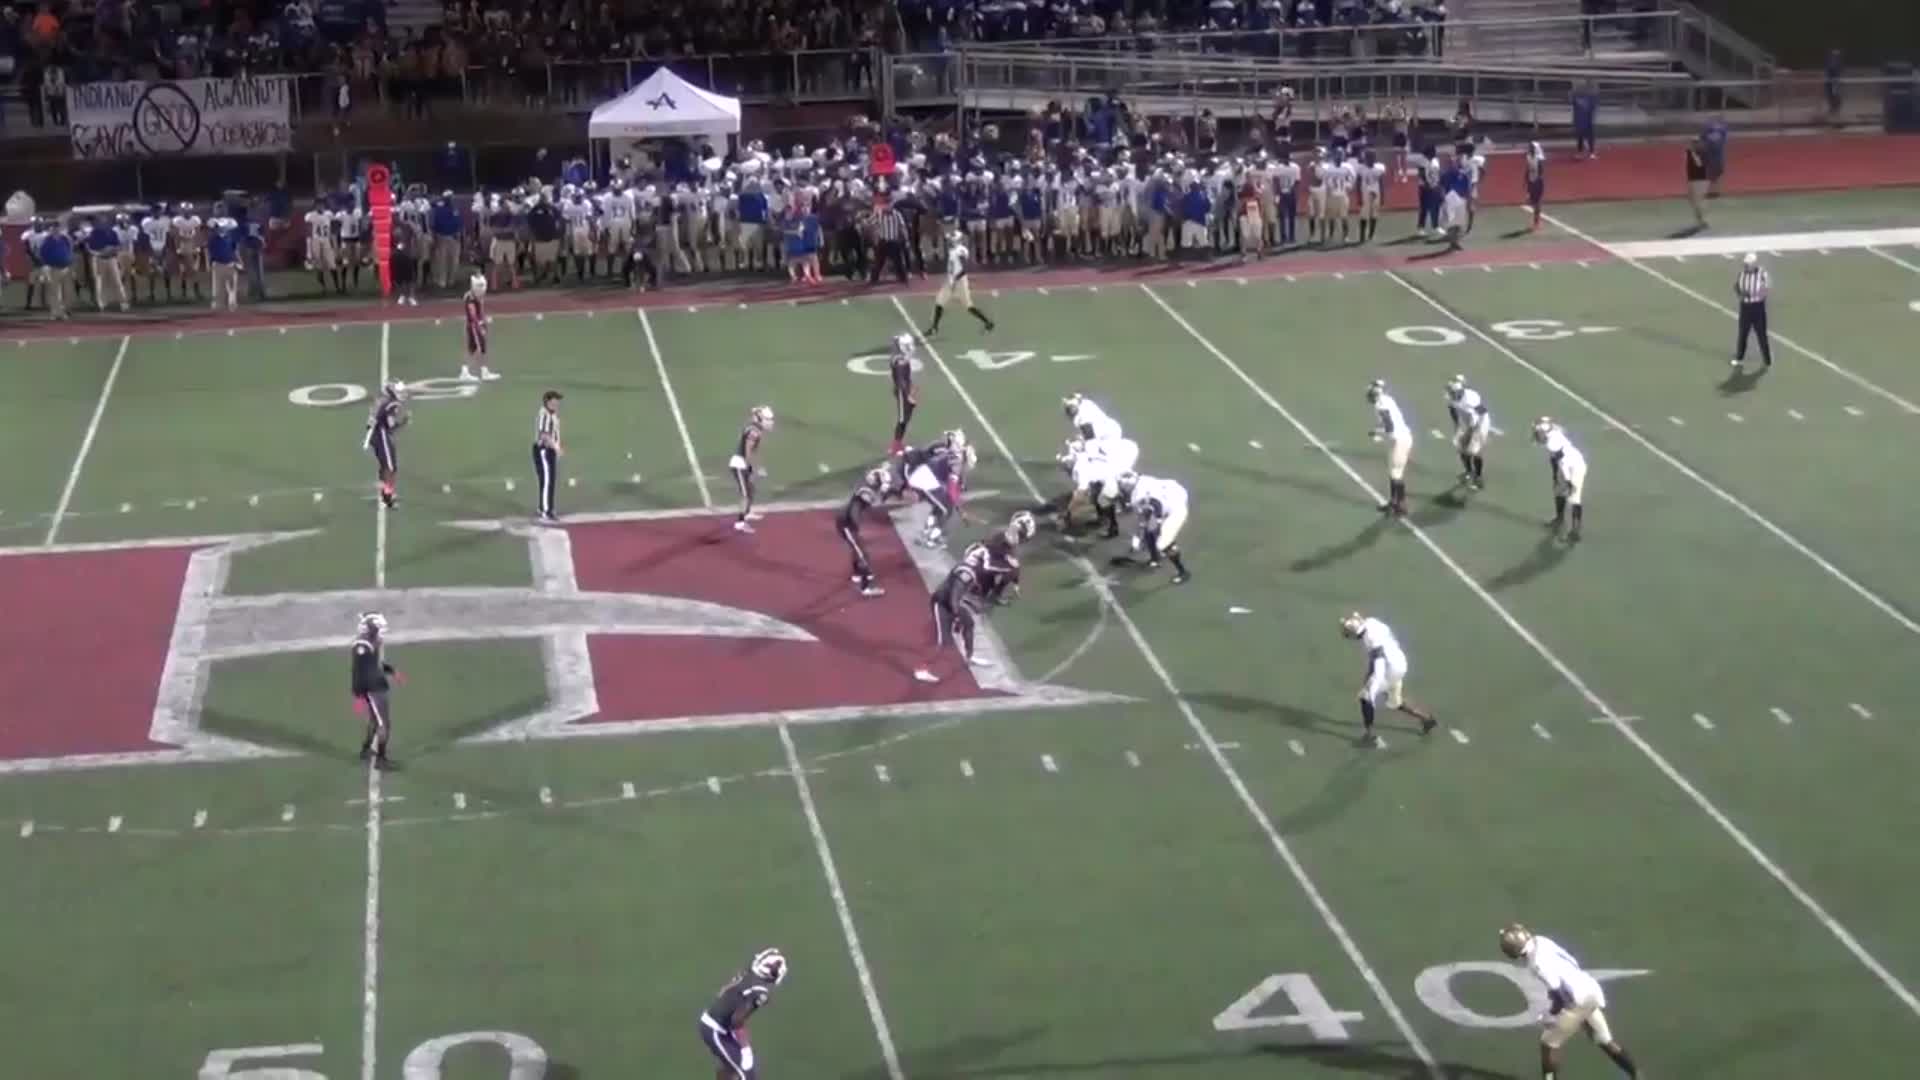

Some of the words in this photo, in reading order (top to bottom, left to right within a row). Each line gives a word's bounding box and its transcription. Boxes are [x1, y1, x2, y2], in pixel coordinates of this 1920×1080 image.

[202, 77, 285, 112] AGAINST
[1385, 320, 1574, 346] 30
[1212, 960, 1553, 1041] 40
